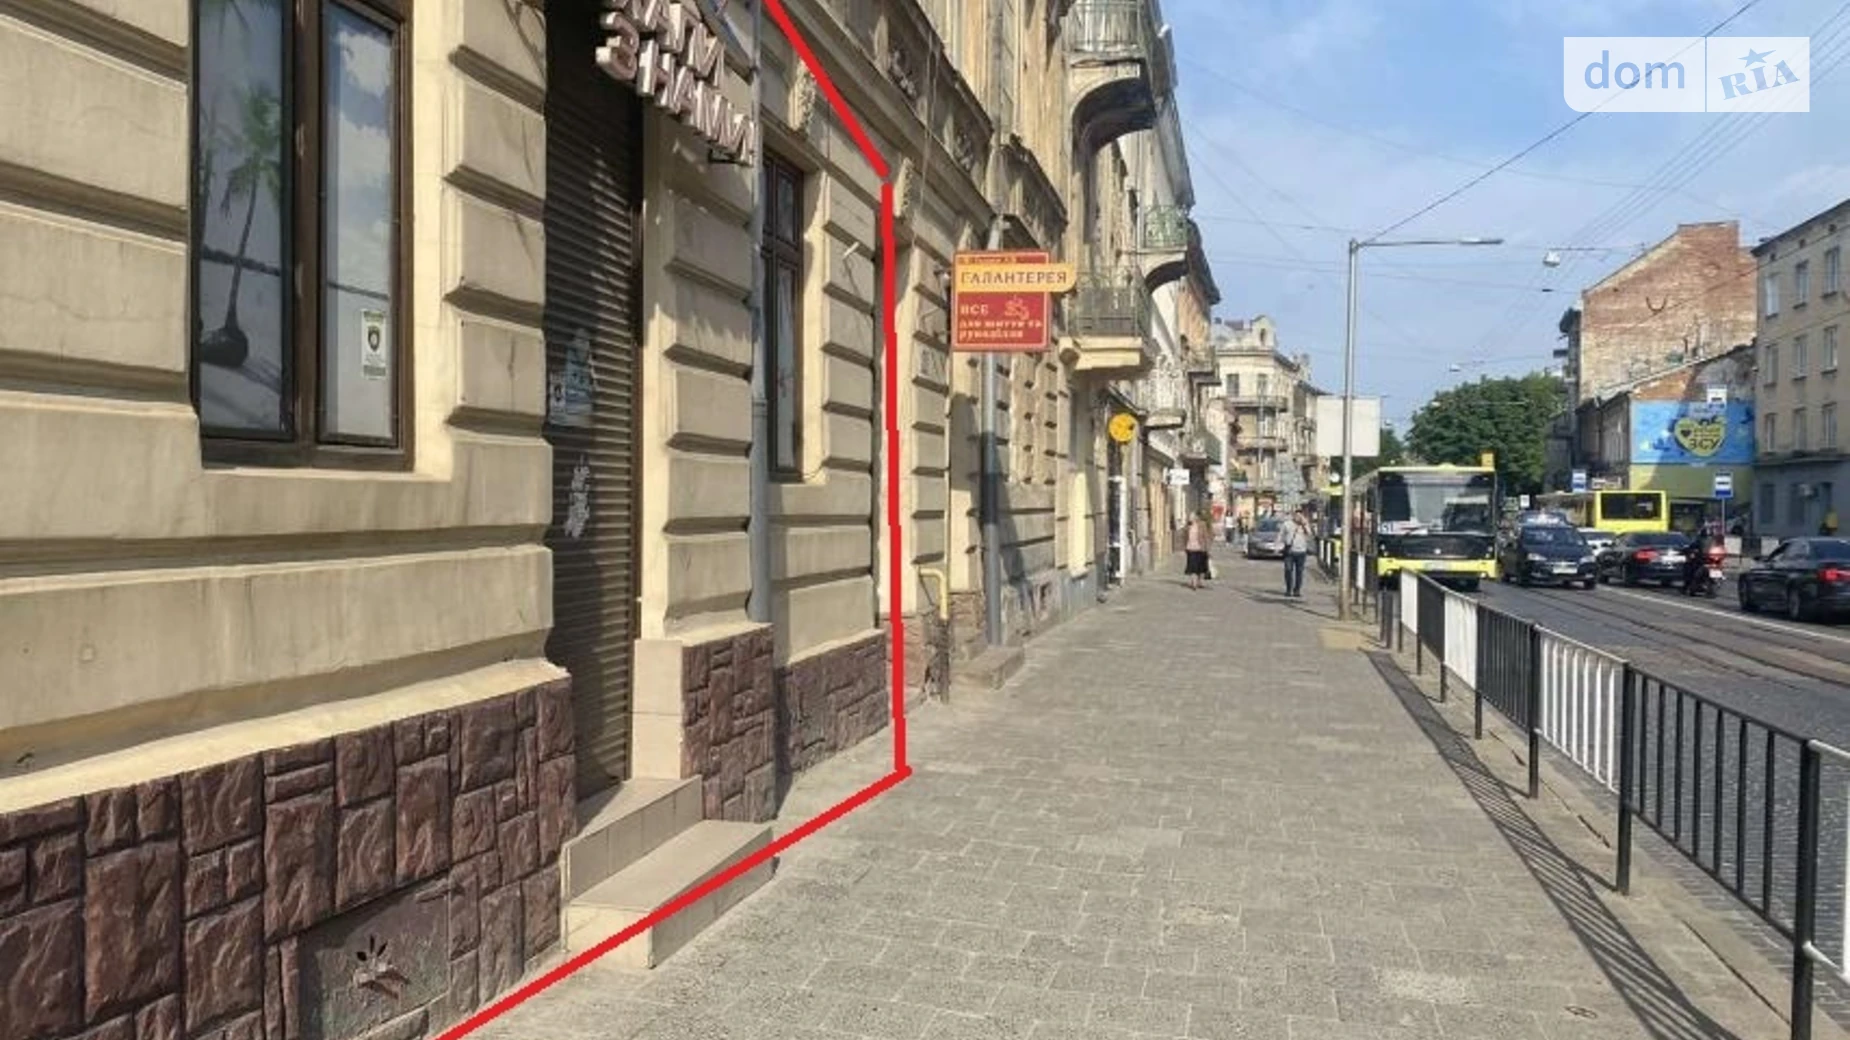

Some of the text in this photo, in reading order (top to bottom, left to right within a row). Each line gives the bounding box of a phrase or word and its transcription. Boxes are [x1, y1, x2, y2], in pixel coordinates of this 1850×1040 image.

[611, 0, 725, 88] АТИ
[960, 271, 1067, 284] ГАЛАНТЕРЕЯ
[1689, 438, 1721, 450] ЗСУ
